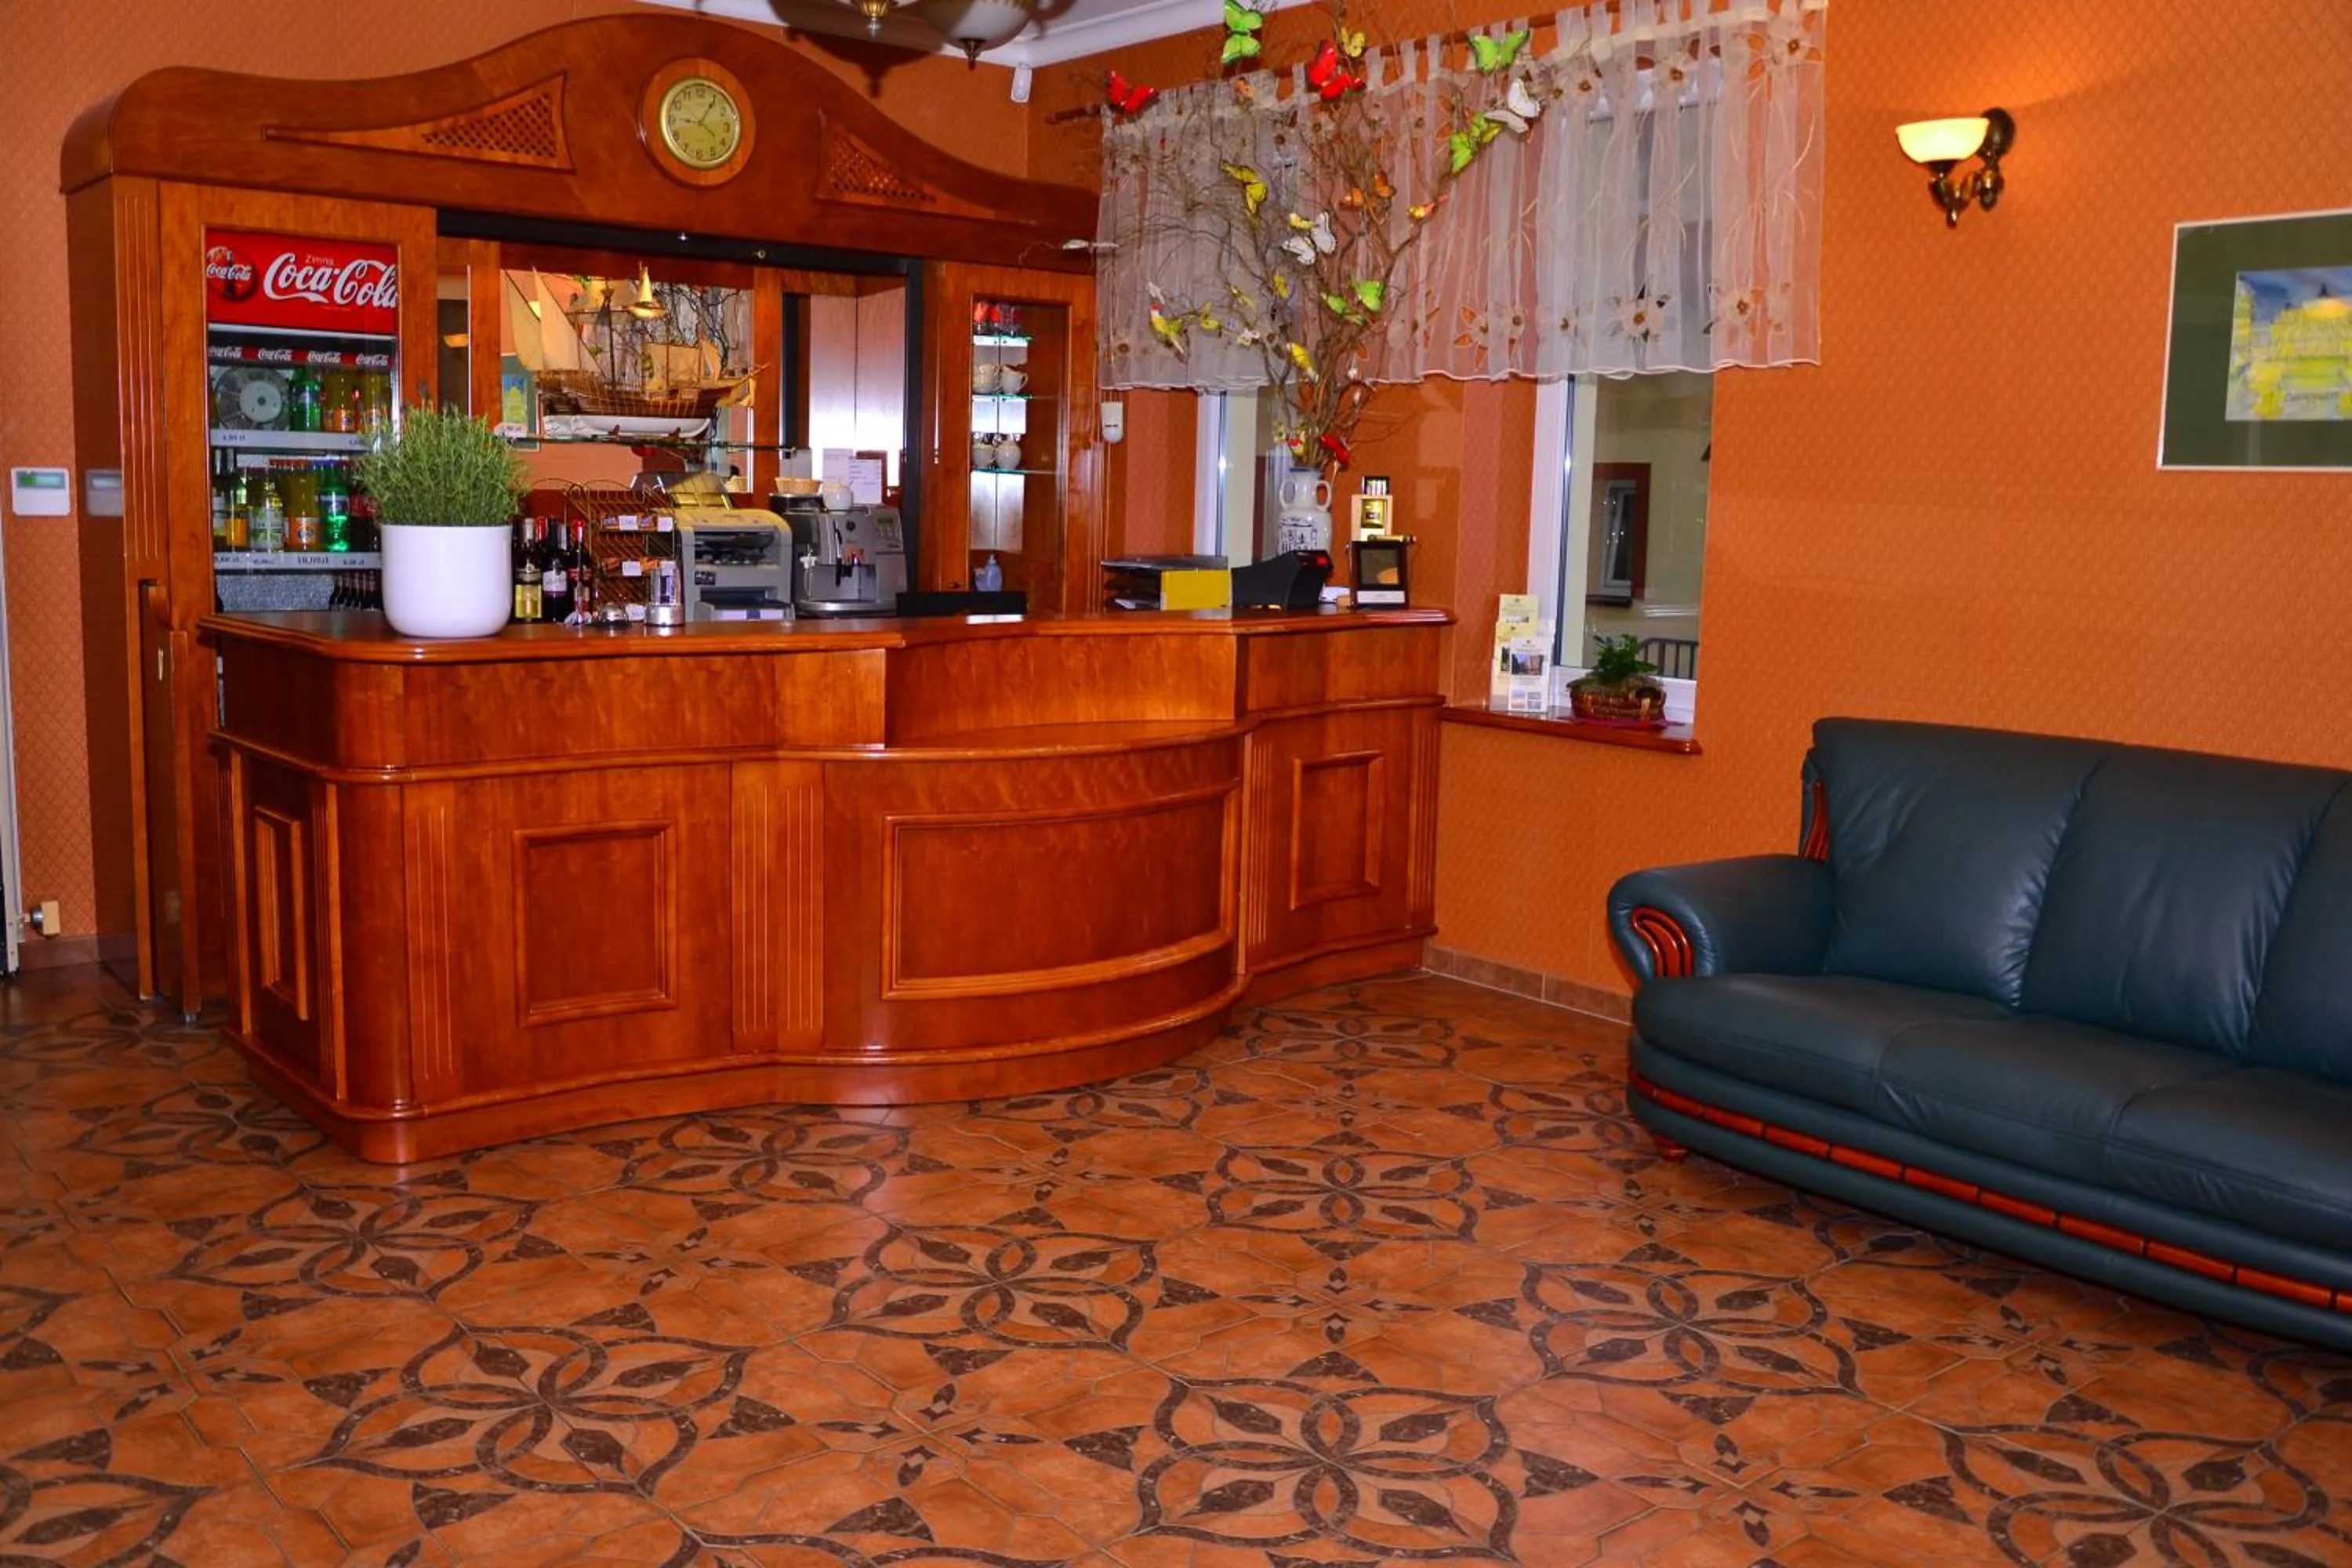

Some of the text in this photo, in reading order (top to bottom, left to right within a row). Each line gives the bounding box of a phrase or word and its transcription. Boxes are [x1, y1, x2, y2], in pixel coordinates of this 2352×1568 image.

[206, 263, 252, 281] Coca-Cola
[263, 252, 397, 308] Coca-Cola
[258, 348, 292, 361] Coca-Cola
[307, 350, 342, 364] Coca-Cola
[355, 353, 389, 366] Coca-Cola
